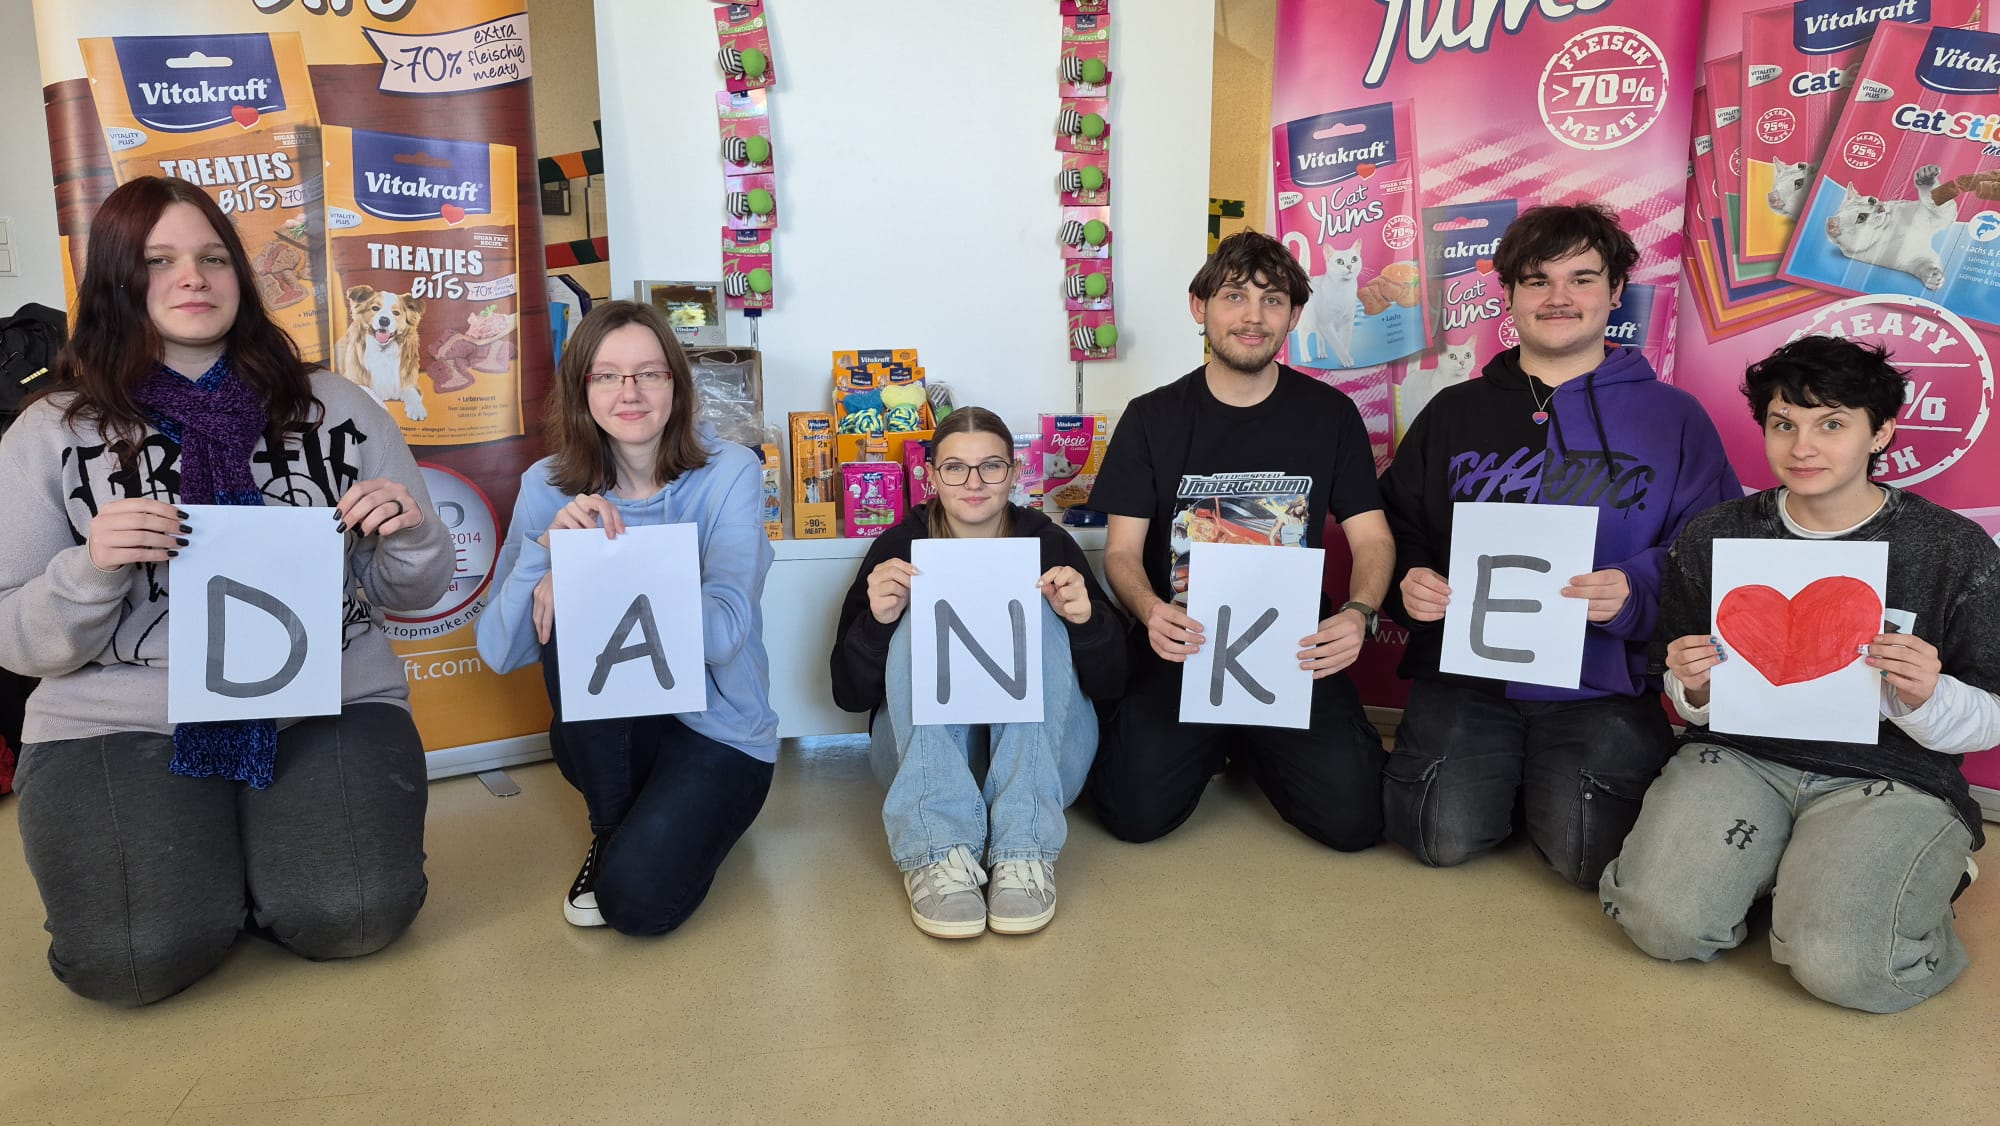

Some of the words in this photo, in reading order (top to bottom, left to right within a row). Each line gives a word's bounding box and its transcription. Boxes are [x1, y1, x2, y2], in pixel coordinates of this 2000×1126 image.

[1804, 0, 1918, 35] Vitakraft
[474, 23, 516, 44] extra
[390, 46, 463, 83] >70%
[468, 44, 526, 66] fleischig
[1559, 34, 1652, 70] FLEISCH
[1933, 46, 2000, 74] Vitak
[473, 64, 519, 82] meaty
[138, 78, 268, 105] Vitakraft
[1560, 111, 1638, 142] MEAT
[1763, 121, 1789, 133] 95%
[159, 151, 293, 187] TREATIES
[1297, 140, 1386, 171] Vitakraft
[364, 171, 479, 202] Vitakraft
[1331, 184, 1368, 210] Cat
[1307, 196, 1385, 244] Yums
[367, 243, 484, 276] TREATIES
[1447, 280, 1486, 305] Cat
[1051, 433, 1086, 447] Poésie
[1470, 553, 1552, 664] E
[206, 575, 308, 699] D
[587, 593, 675, 695] A
[934, 599, 1028, 705] N
[1209, 604, 1280, 707] K
